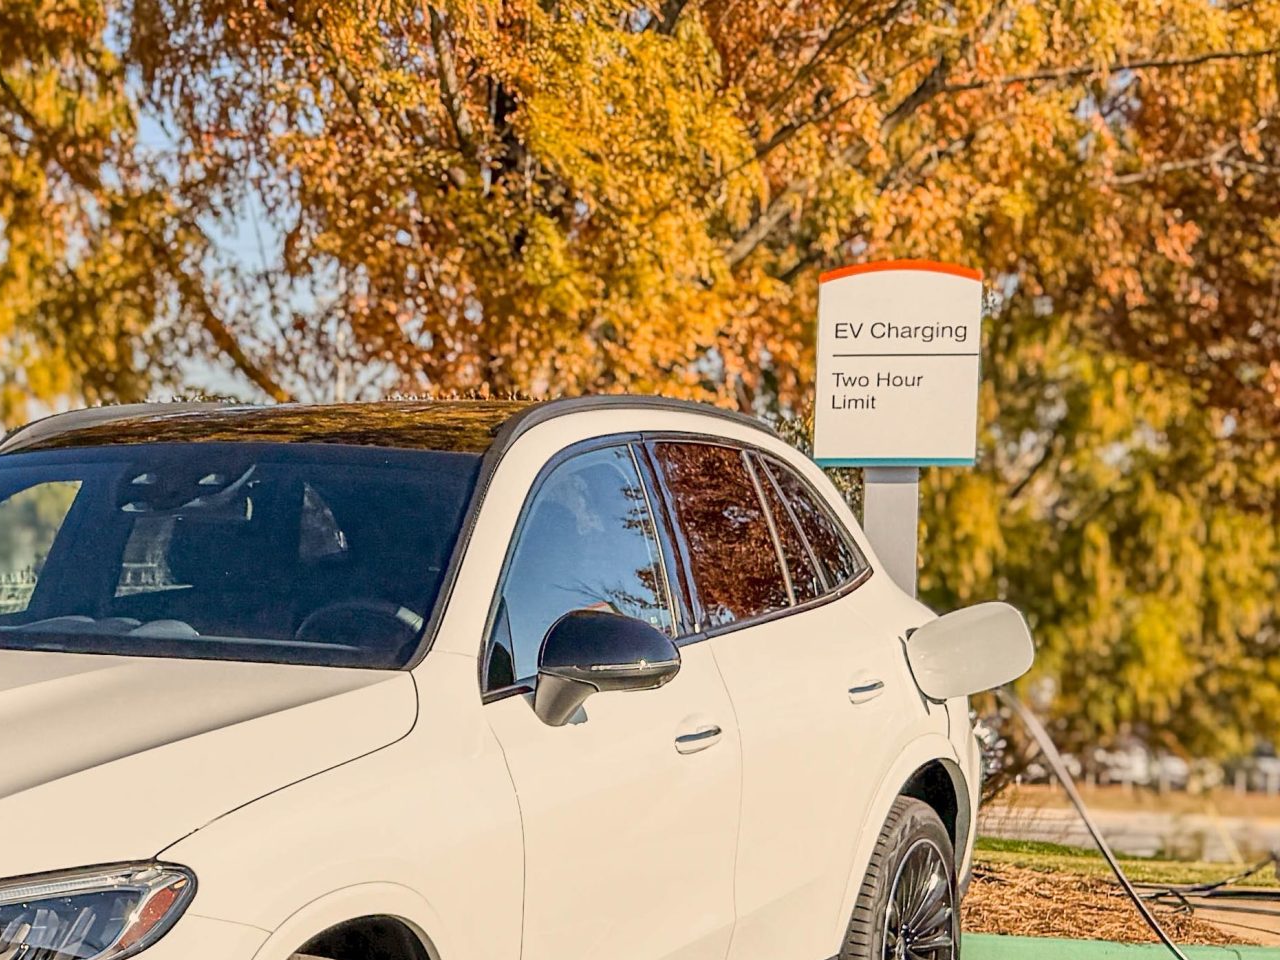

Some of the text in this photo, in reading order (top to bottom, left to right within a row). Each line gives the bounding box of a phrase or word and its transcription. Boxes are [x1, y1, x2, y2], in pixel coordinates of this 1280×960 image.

[834, 321, 968, 343] EV Charging
[832, 372, 924, 388] Two Hour
[831, 394, 876, 410] Limit
